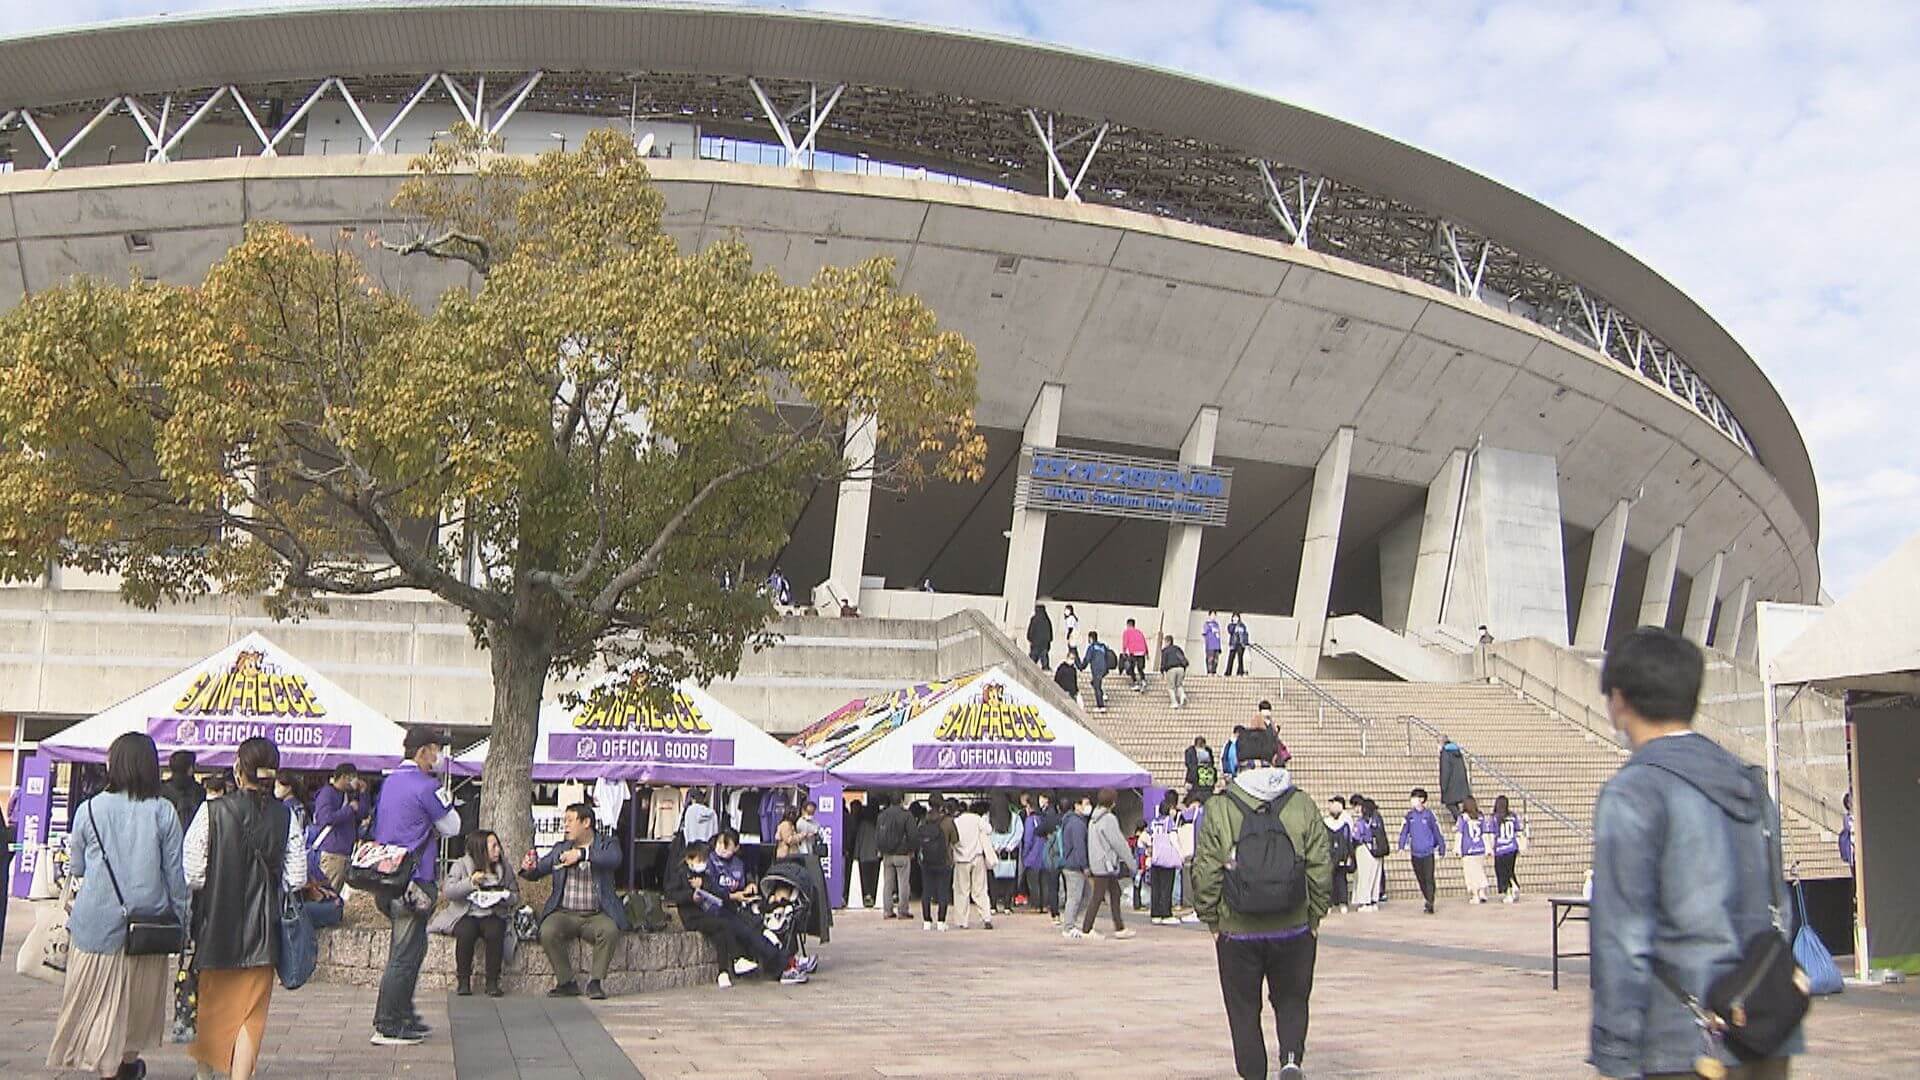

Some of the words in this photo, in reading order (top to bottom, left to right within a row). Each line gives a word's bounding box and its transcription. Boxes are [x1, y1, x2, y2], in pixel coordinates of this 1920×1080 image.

[174, 671, 326, 716] SANFRECCE
[934, 703, 1056, 740] SANFRECCE
[274, 727, 323, 745] GOODS
[602, 739, 661, 758] OFFICIAL
[665, 742, 708, 760] GOODS
[960, 748, 1013, 765] OFFICIAL
[1015, 752, 1053, 767] GOODS
[1500, 820, 1514, 841] 10
